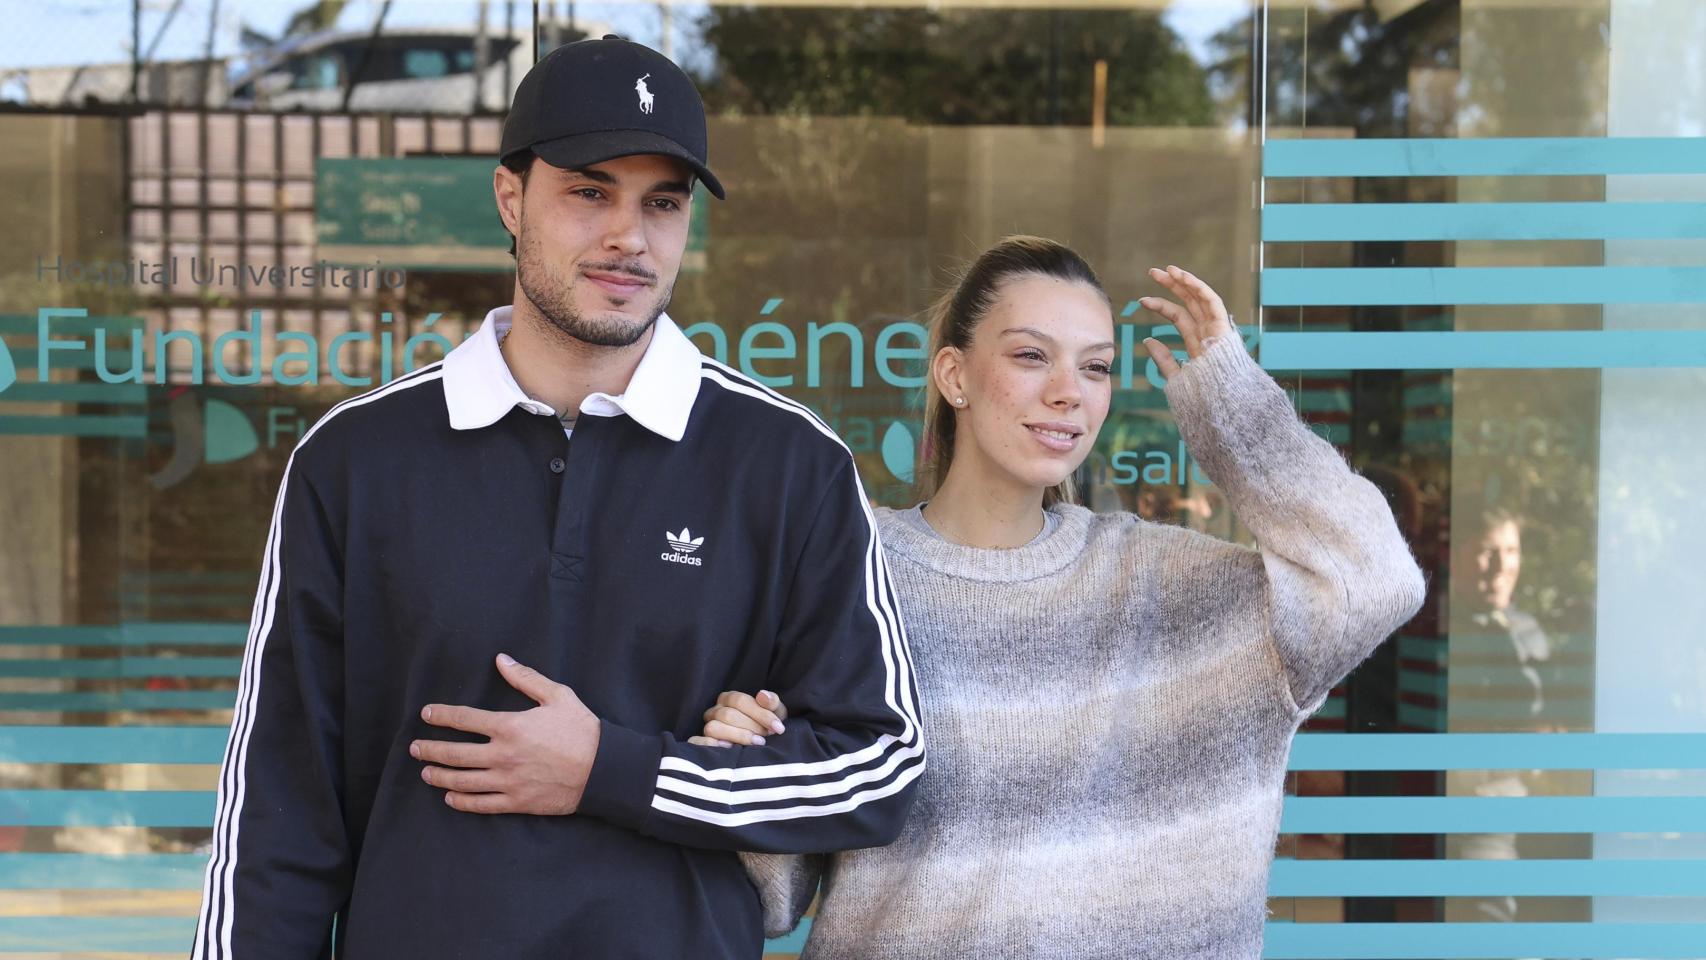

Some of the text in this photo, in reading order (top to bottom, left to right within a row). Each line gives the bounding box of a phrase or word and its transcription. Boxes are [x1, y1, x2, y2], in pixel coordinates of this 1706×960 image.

[37, 255, 407, 289] Hospital Universitario
[38, 308, 470, 386] Fundació
[661, 552, 702, 566] adidas
